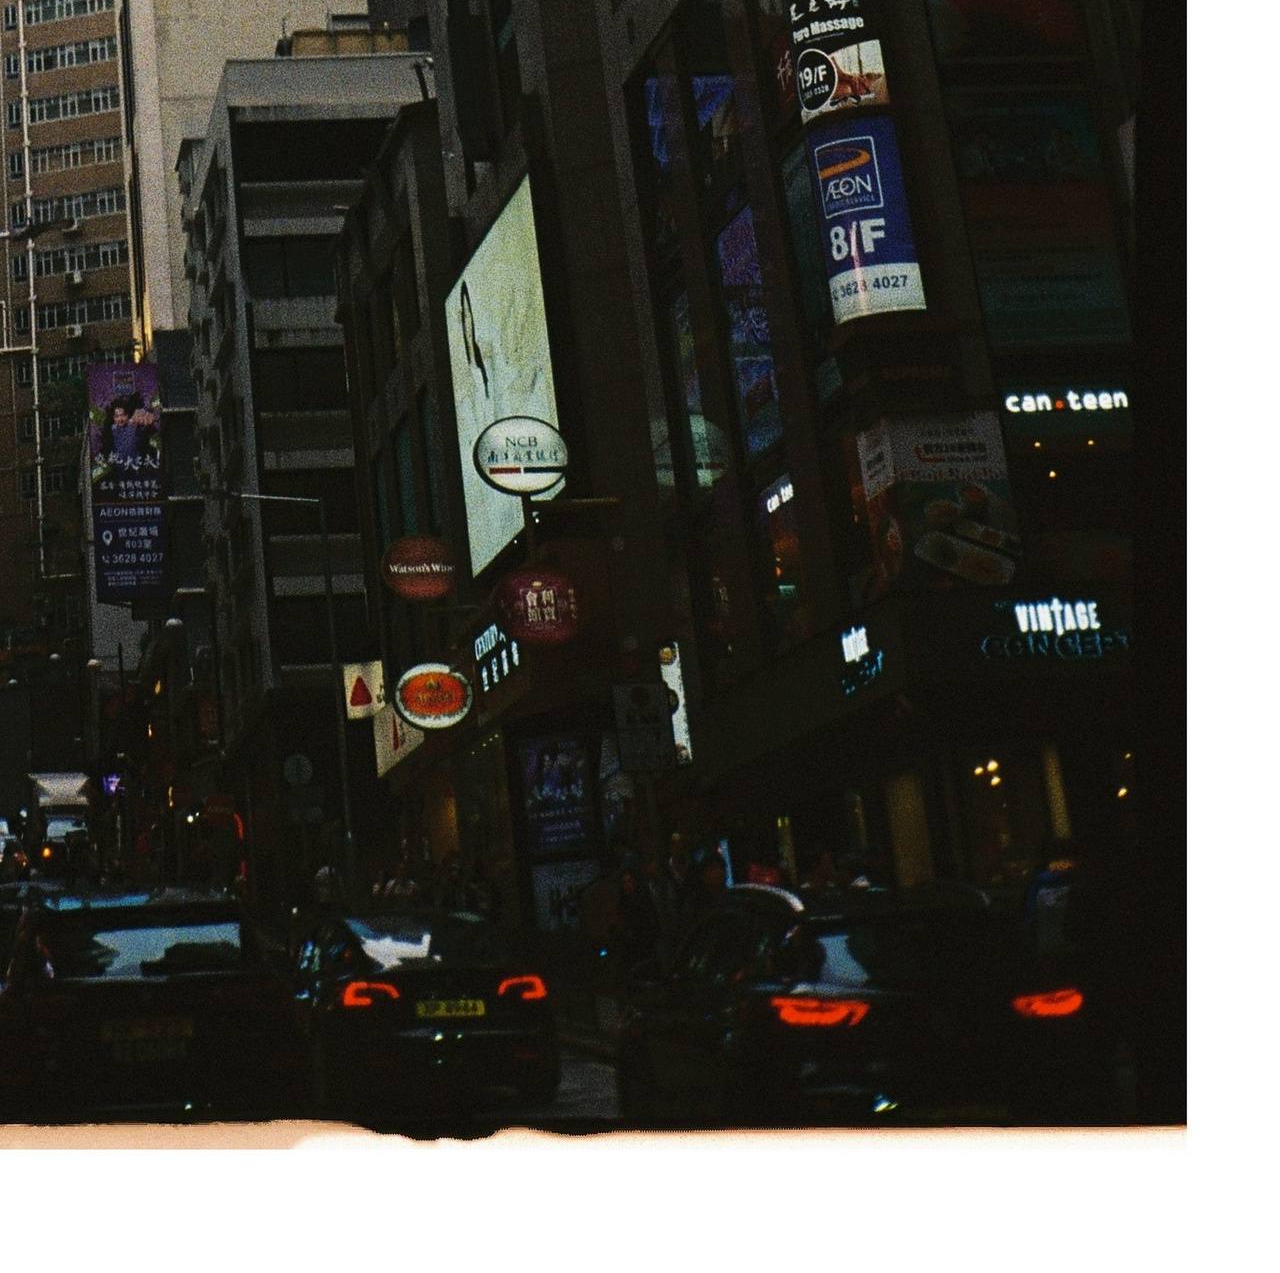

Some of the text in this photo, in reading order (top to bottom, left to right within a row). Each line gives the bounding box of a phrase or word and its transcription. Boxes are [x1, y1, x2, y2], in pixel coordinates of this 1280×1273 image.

[810, 16, 864, 36] Massage
[800, 64, 827, 90] 19/F
[830, 217, 886, 261] 8/F
[873, 274, 908, 291] 4027
[505, 437, 538, 448] NCB
[389, 563, 430, 574] Watson's
[1014, 597, 1101, 635] VINTAGE
